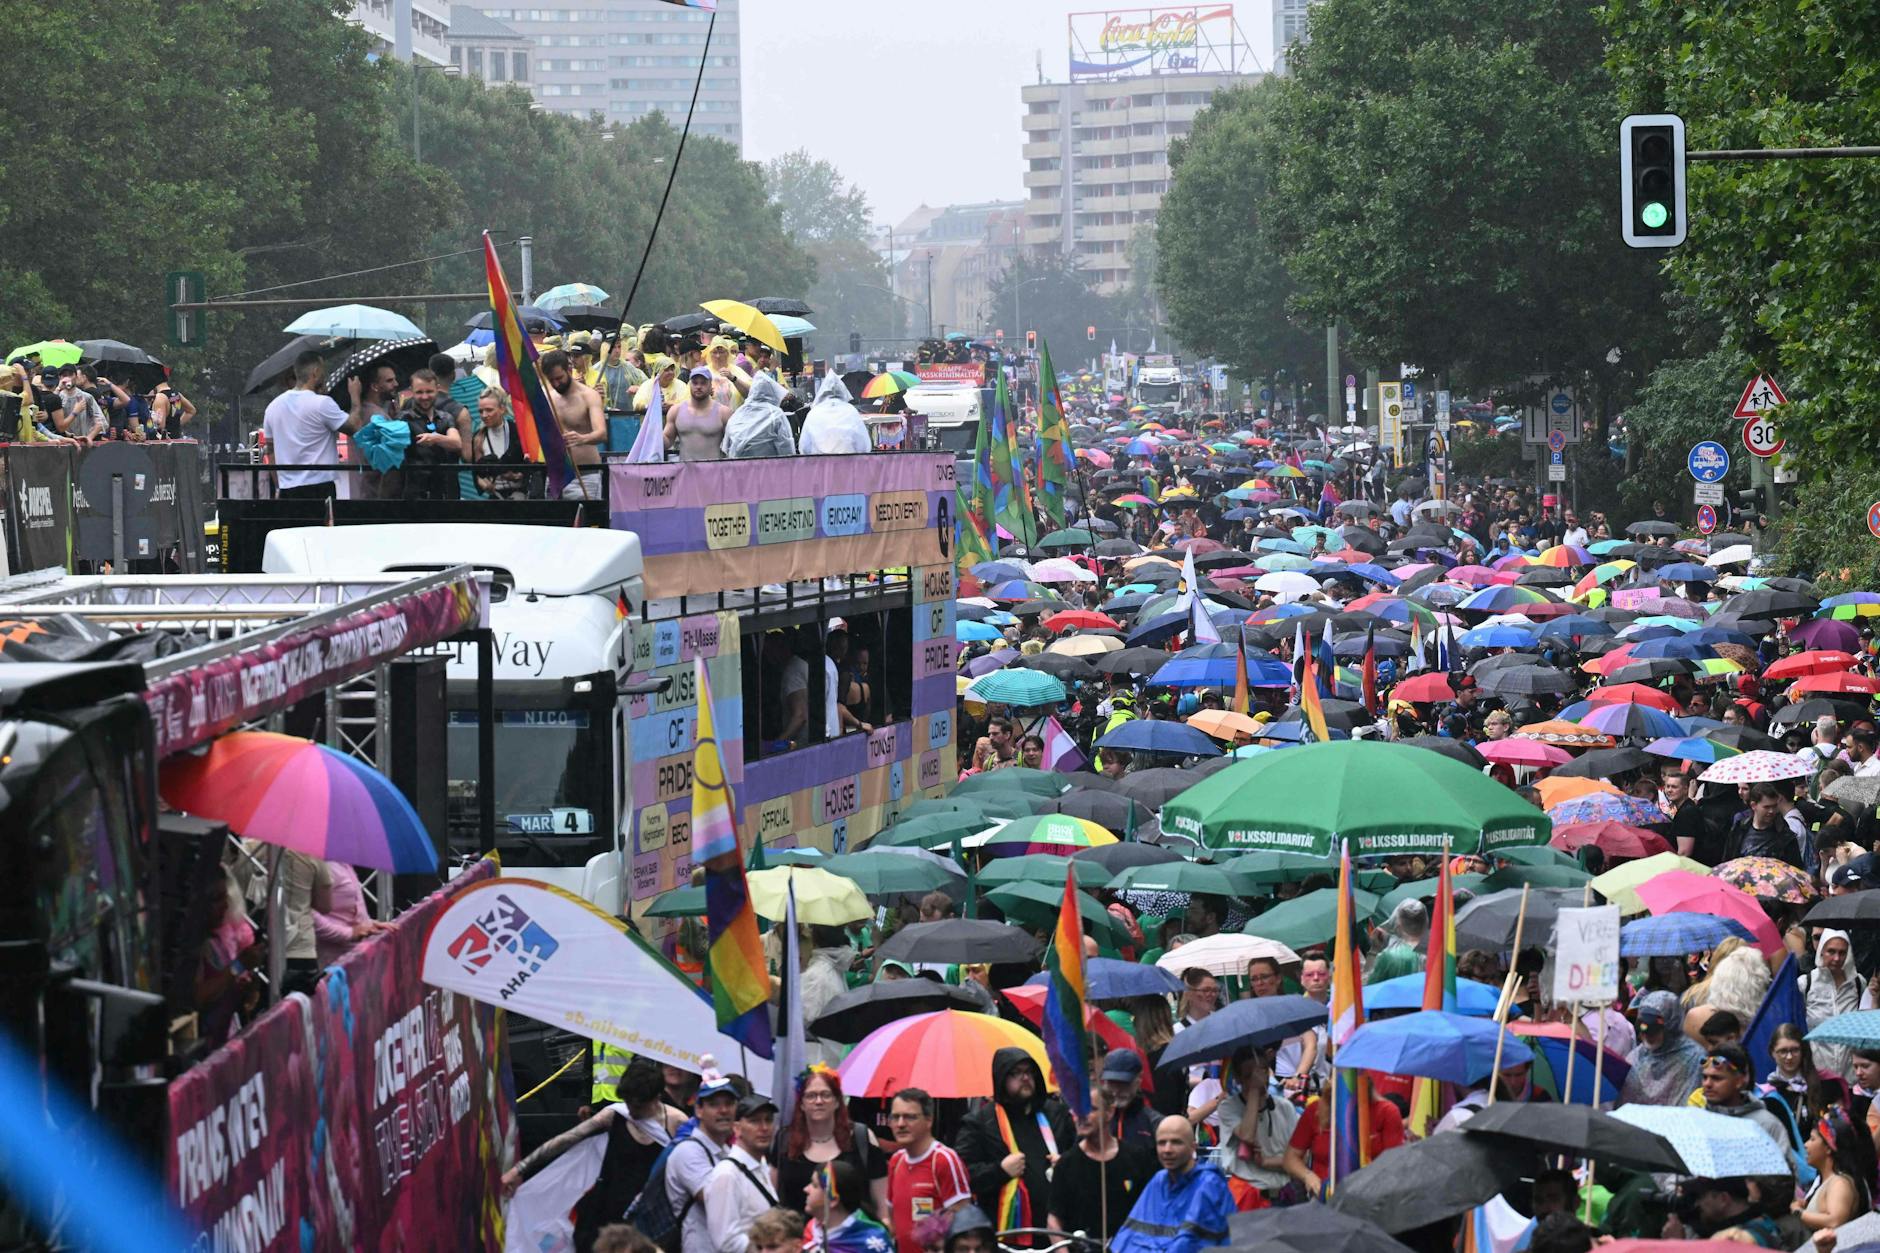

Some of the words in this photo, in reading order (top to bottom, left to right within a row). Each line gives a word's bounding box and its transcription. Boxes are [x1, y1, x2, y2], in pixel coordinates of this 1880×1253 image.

[1099, 11, 1197, 51] Coca-Cola
[644, 476, 676, 497] TONIGHT
[708, 516, 746, 537] TOGETHER
[758, 514, 769, 533] WE
[924, 571, 950, 598] HOUSE
[931, 609, 943, 634] OF
[925, 644, 950, 673] PRIDE
[525, 711, 568, 725] NICO
[669, 718, 684, 749] OF
[659, 761, 692, 797] PRIDE
[825, 783, 854, 817] HOUSE
[564, 812, 579, 832] 4
[761, 807, 790, 832] OFFICIAL
[833, 826, 845, 854] OF
[1228, 830, 1315, 849] VOLKSSOLIDARITÄT
[499, 970, 531, 1000] AHA
